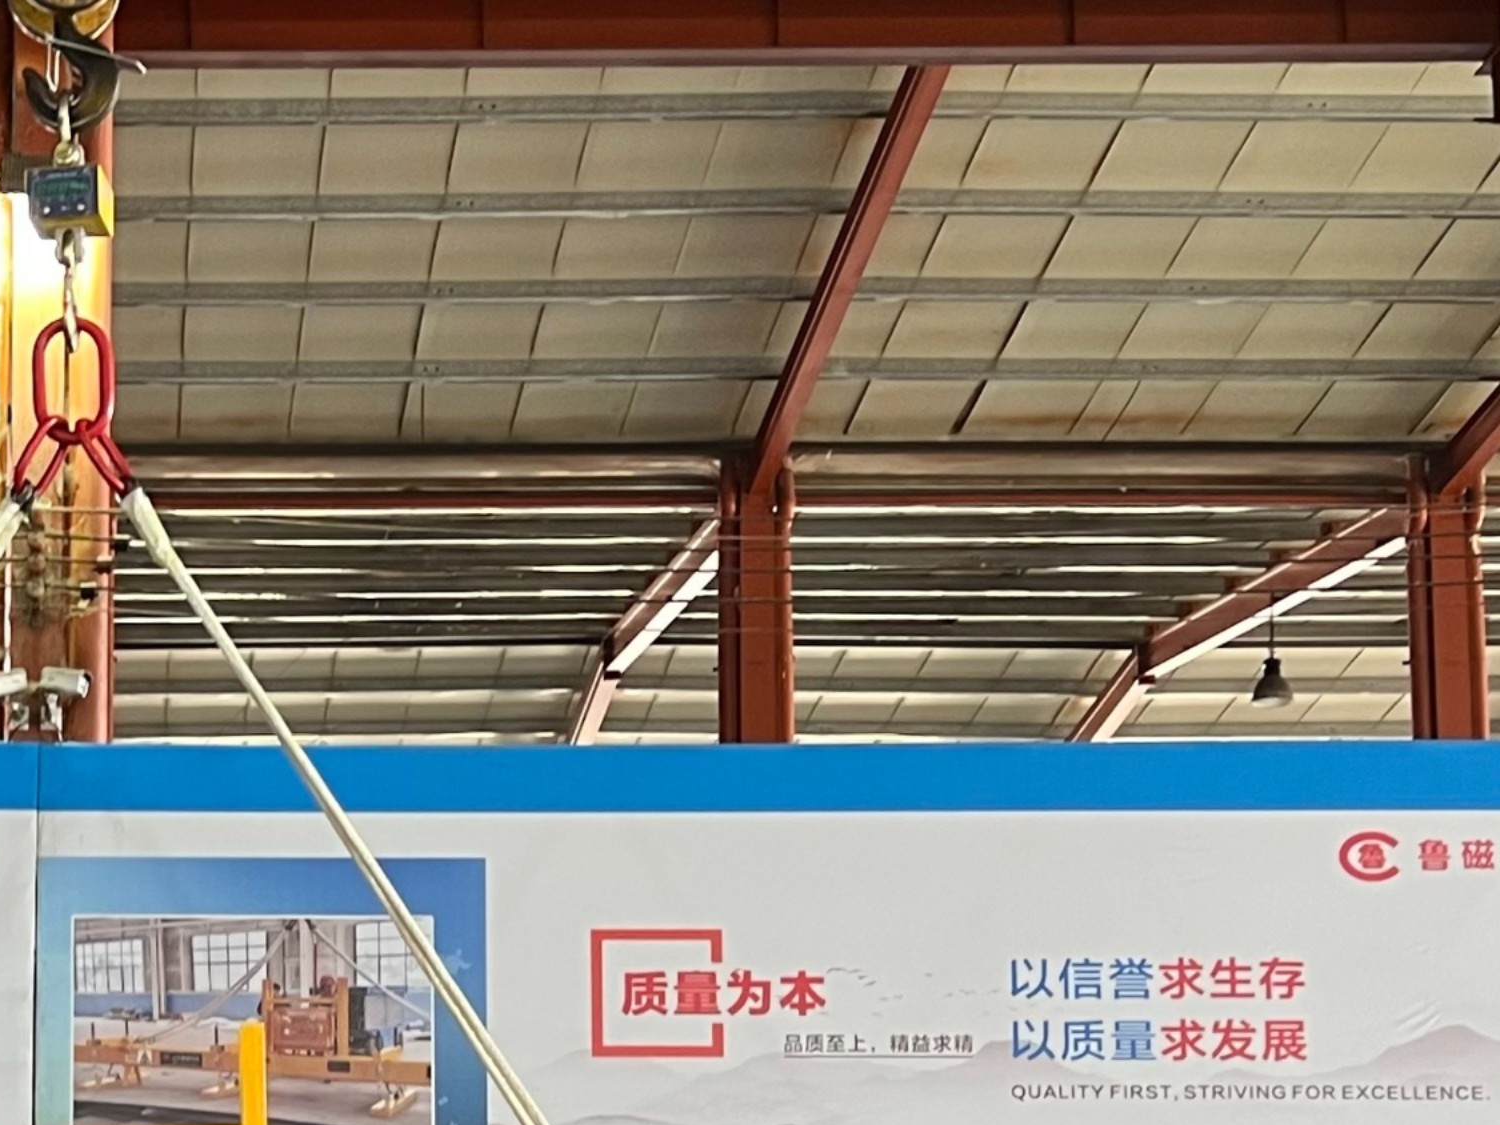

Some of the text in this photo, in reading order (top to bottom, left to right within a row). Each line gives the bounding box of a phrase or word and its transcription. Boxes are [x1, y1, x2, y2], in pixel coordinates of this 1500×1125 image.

[1418, 839, 1495, 871] 鲁磁
[621, 970, 826, 1018] 质量为本
[1010, 957, 1305, 1001] 以信誉求生存
[783, 1033, 974, 1054] 品质至上，精益求精
[1011, 1018, 1308, 1062] 以质量求发展
[1011, 1083, 1491, 1103] QUALITY FIRST, STRIVING FOR EXCELLENCE.
